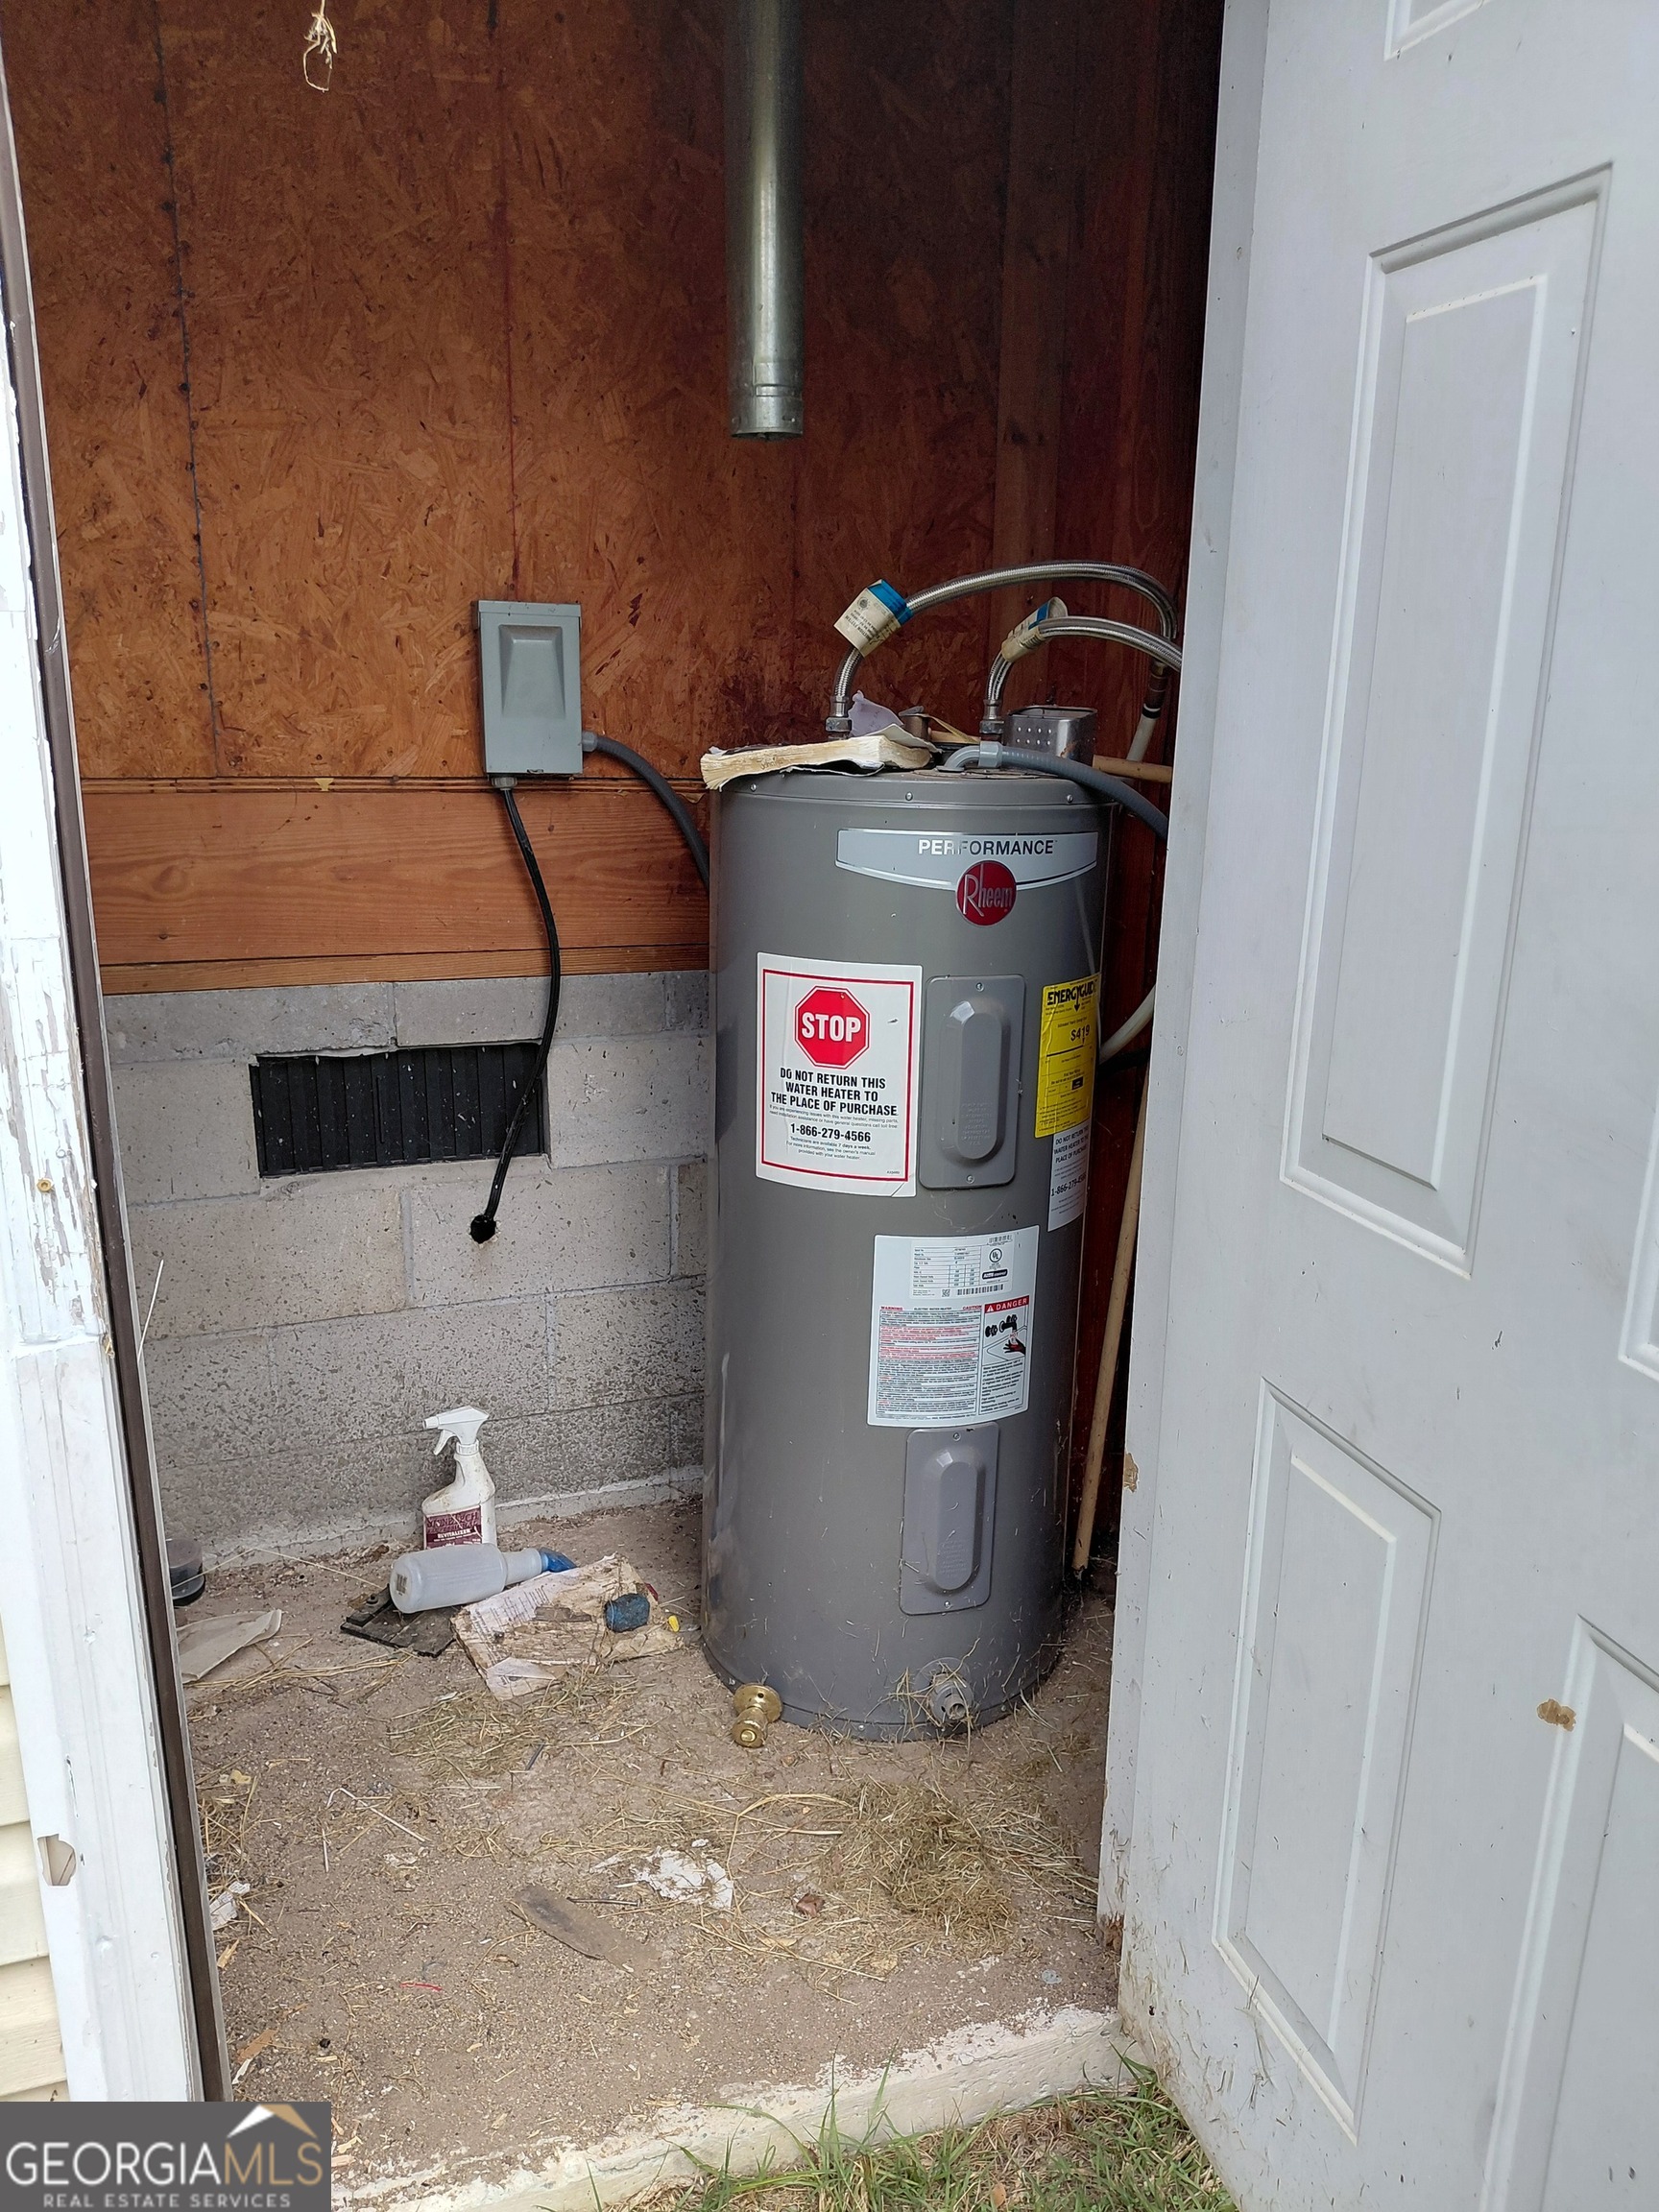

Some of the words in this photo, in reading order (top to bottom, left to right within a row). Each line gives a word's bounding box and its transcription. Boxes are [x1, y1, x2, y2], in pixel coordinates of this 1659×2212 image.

[918, 839, 1054, 855] PERFORMANCE
[963, 863, 1013, 917] Rheem
[1046, 980, 1097, 1005] ENERGYGUID
[801, 1011, 861, 1043] STOP
[780, 1068, 792, 1079] DO
[795, 1070, 814, 1083] NOT
[816, 1072, 857, 1088] RETURN
[861, 1076, 886, 1089] THIS
[771, 1092, 787, 1105] THE
[789, 1095, 820, 1110] PLACE
[823, 1100, 836, 1112] OF
[785, 1081, 818, 1096] WATER
[821, 1087, 860, 1101] HEATER
[864, 1091, 878, 1102] TO
[790, 1122, 871, 1142] 1-866-279-4566
[996, 1298, 1027, 1310] DANGER
